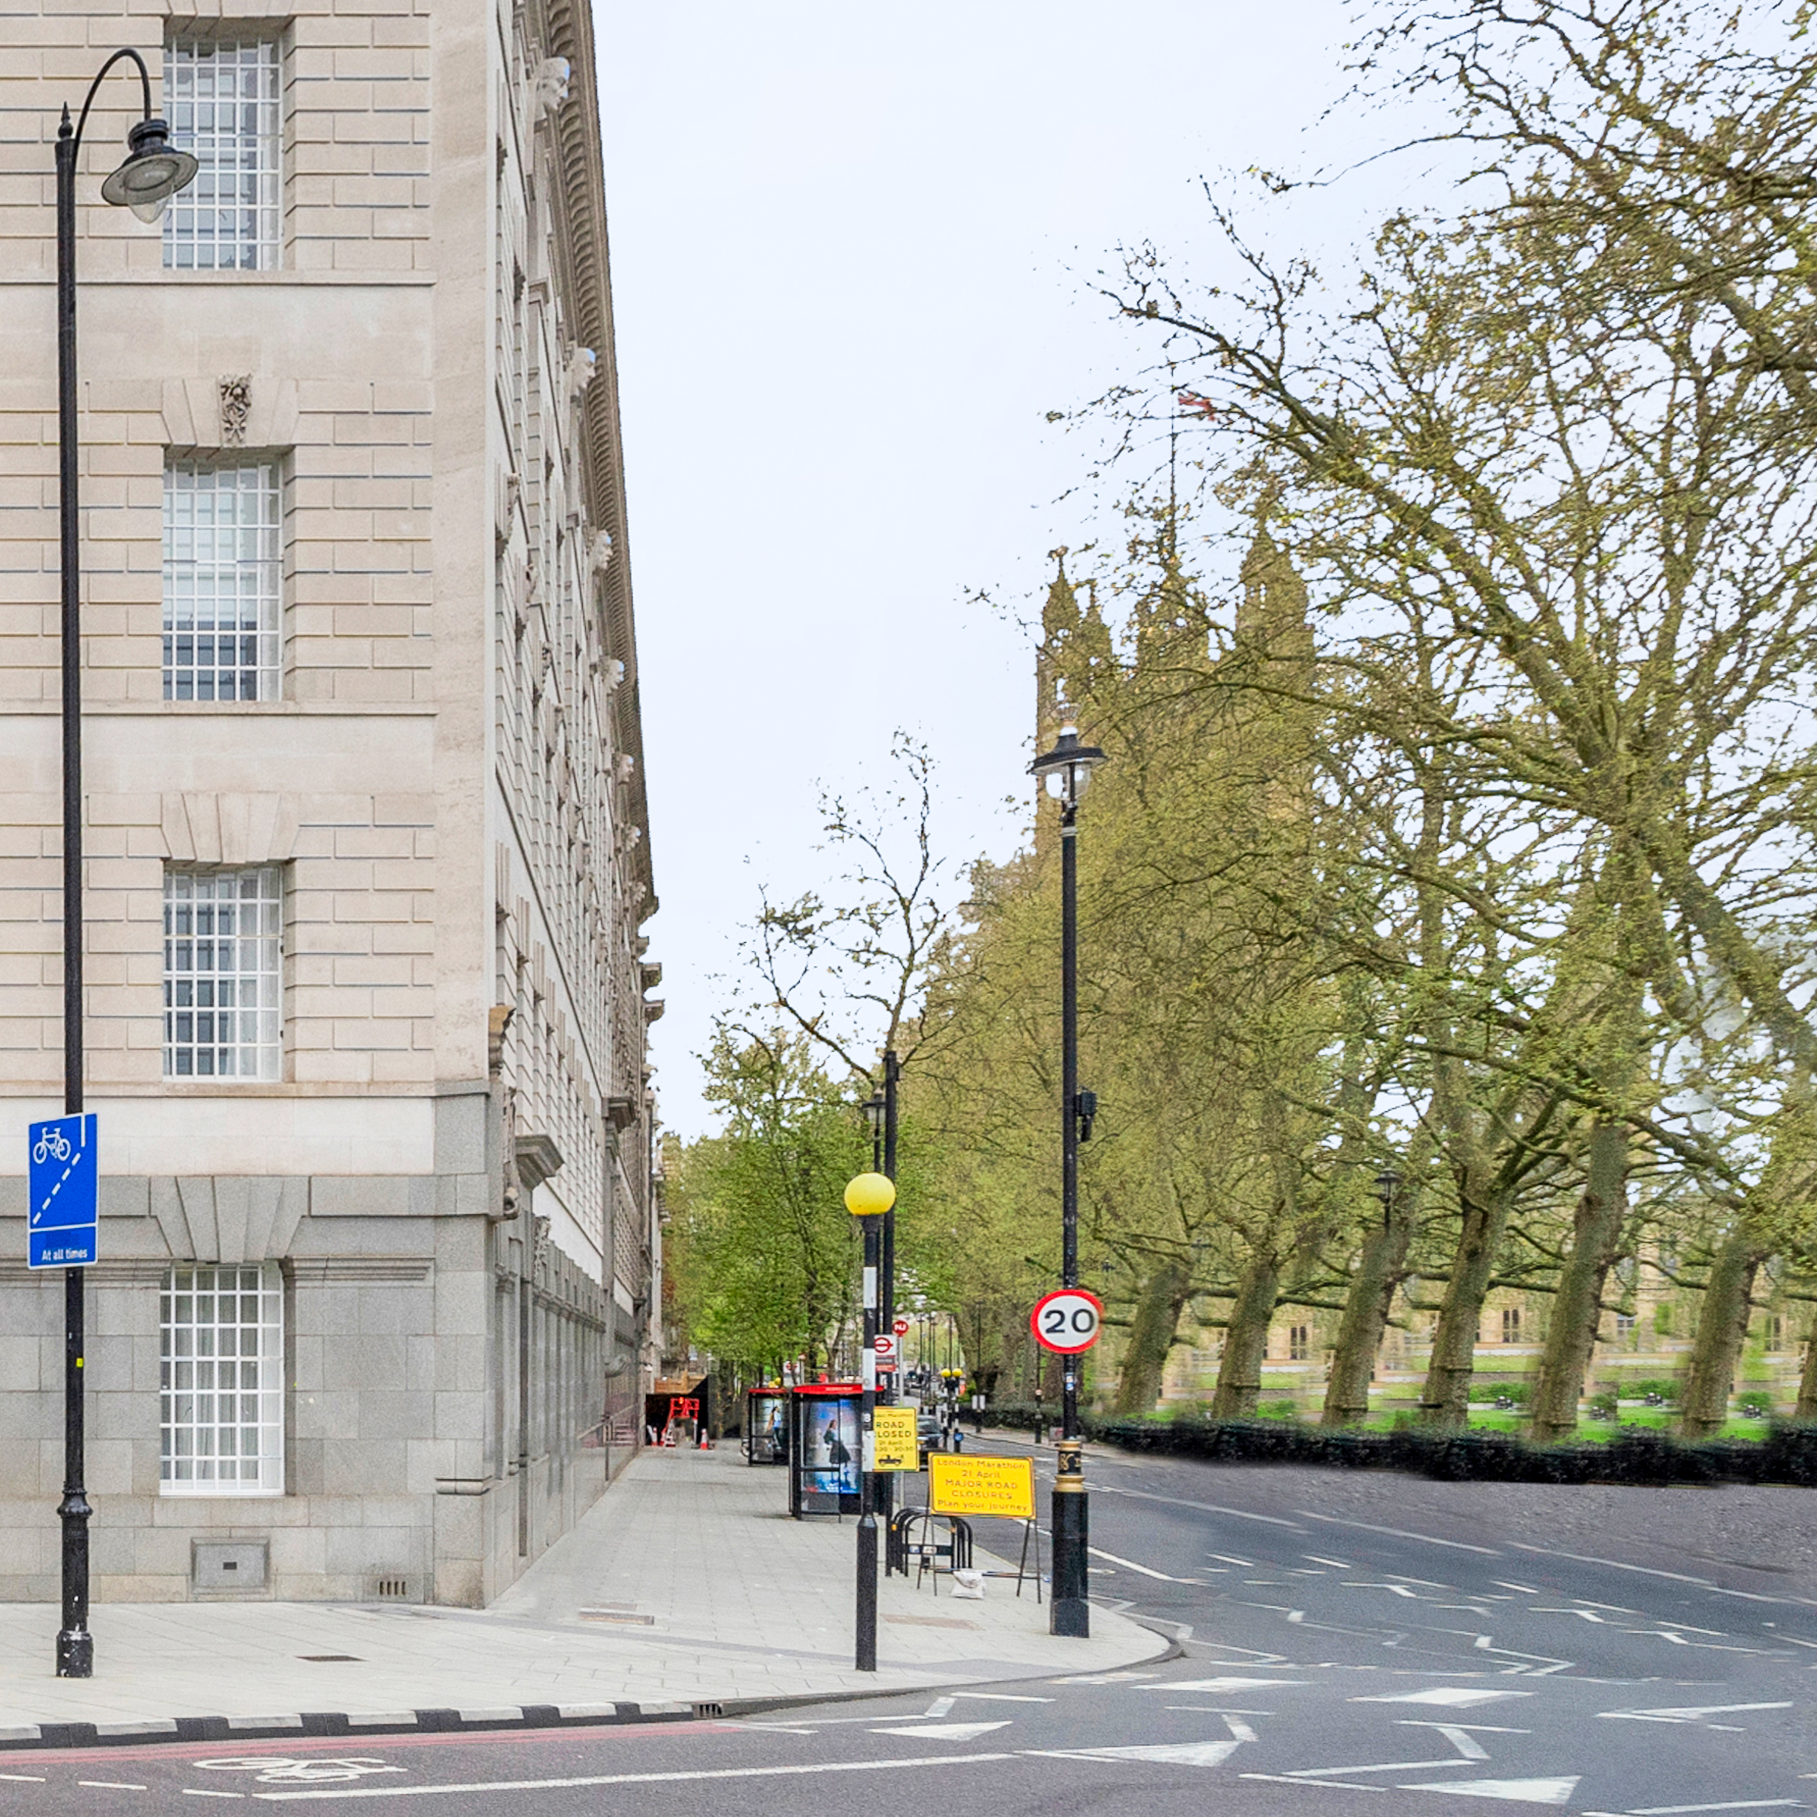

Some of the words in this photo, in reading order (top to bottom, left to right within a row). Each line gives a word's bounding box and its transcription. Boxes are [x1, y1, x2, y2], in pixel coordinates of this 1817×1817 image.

[41, 1250, 52, 1261] At
[53, 1249, 64, 1260] all
[1044, 1308, 1095, 1333] 20
[876, 1421, 905, 1429] ROAD
[874, 1430, 912, 1438] LOSED
[937, 1459, 973, 1467] London
[977, 1461, 1025, 1469] Marathon
[977, 1471, 1001, 1479] April
[945, 1479, 982, 1488] MAJOR
[952, 1490, 1013, 1499] CLOSURES
[938, 1499, 959, 1507] Plan
[963, 1502, 984, 1510] your
[989, 1503, 1028, 1512] journey
